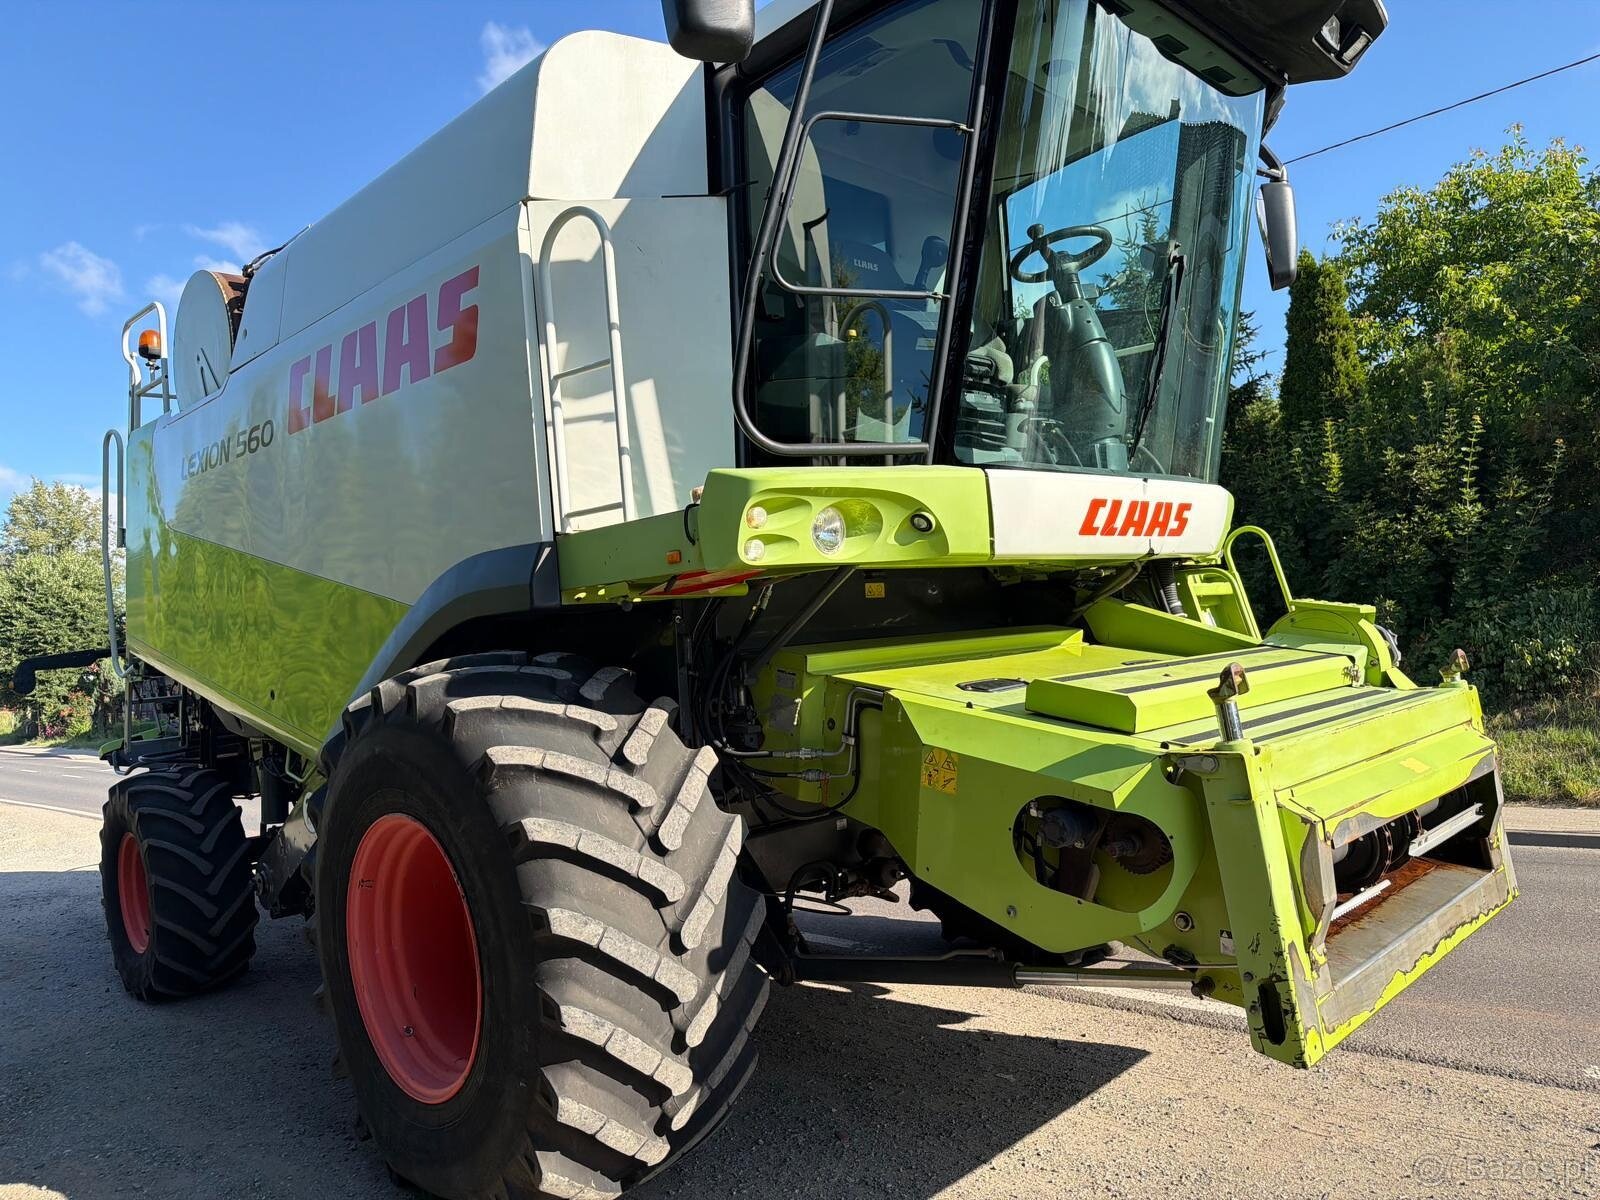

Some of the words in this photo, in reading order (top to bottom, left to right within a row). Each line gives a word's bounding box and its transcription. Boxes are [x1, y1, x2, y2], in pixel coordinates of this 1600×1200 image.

[853, 258, 880, 272] CLAAS
[288, 265, 480, 435] CLAAS
[181, 437, 231, 481] LEXION
[236, 419, 274, 459] 560
[1078, 498, 1193, 537] CLAAS
